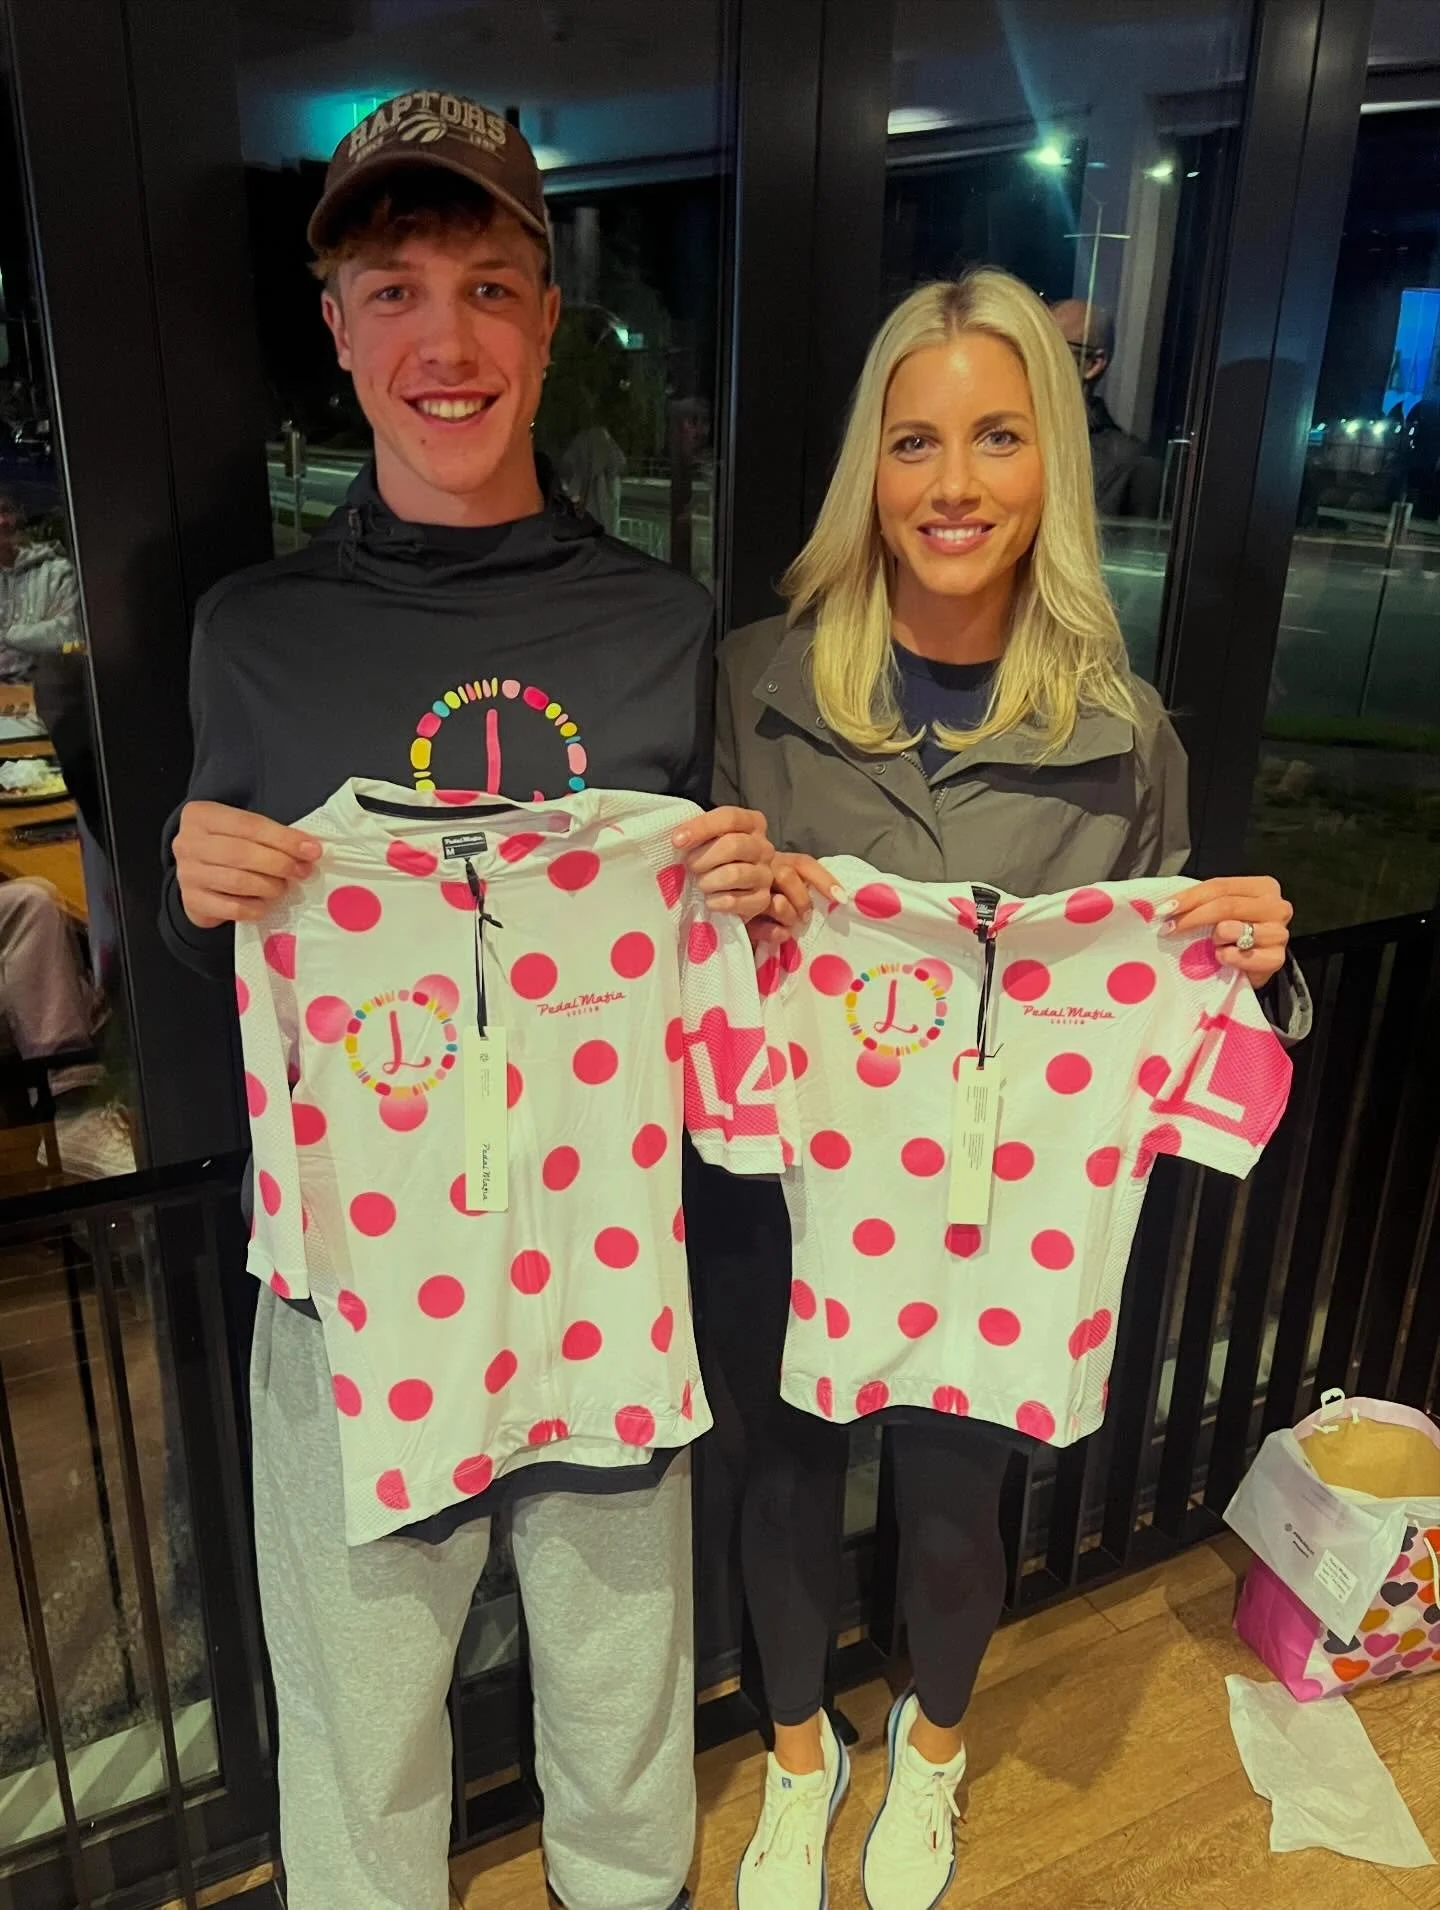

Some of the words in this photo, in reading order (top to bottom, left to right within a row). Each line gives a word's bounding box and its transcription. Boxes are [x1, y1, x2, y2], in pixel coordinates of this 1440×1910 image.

[348, 89, 506, 158] RAPTORS
[446, 847, 456, 857] M
[536, 998, 579, 1016] Pedal
[578, 991, 627, 1005] Mafia
[873, 979, 919, 1034] L
[1022, 1005, 1065, 1017] Pedal
[1066, 1006, 1117, 1020] Mafia
[382, 1010, 432, 1075] L
